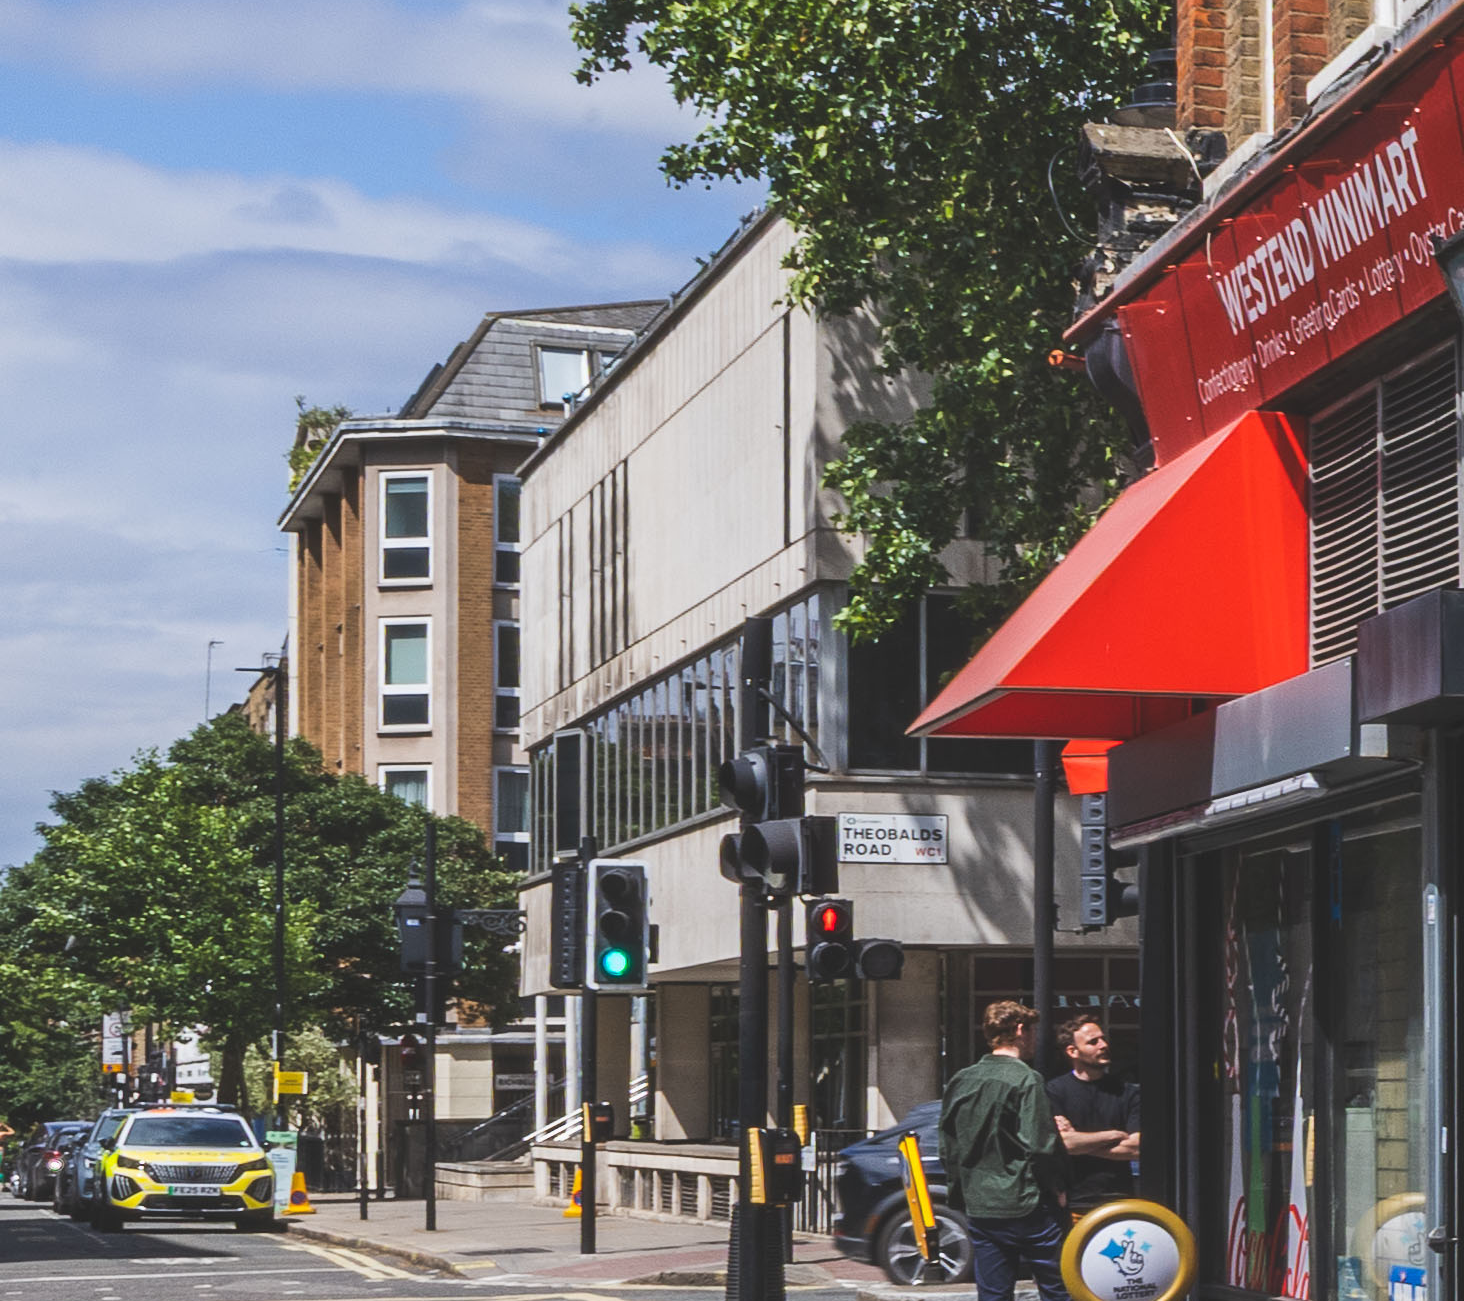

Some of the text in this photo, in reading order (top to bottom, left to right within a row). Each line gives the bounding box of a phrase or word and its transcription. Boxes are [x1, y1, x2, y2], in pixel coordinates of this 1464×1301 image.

[1216, 128, 1428, 337] WESTEND MINIMART
[1363, 251, 1406, 297] Lottey
[843, 827, 944, 841] THEOBALDS
[843, 843, 942, 857] ROAD WC1
